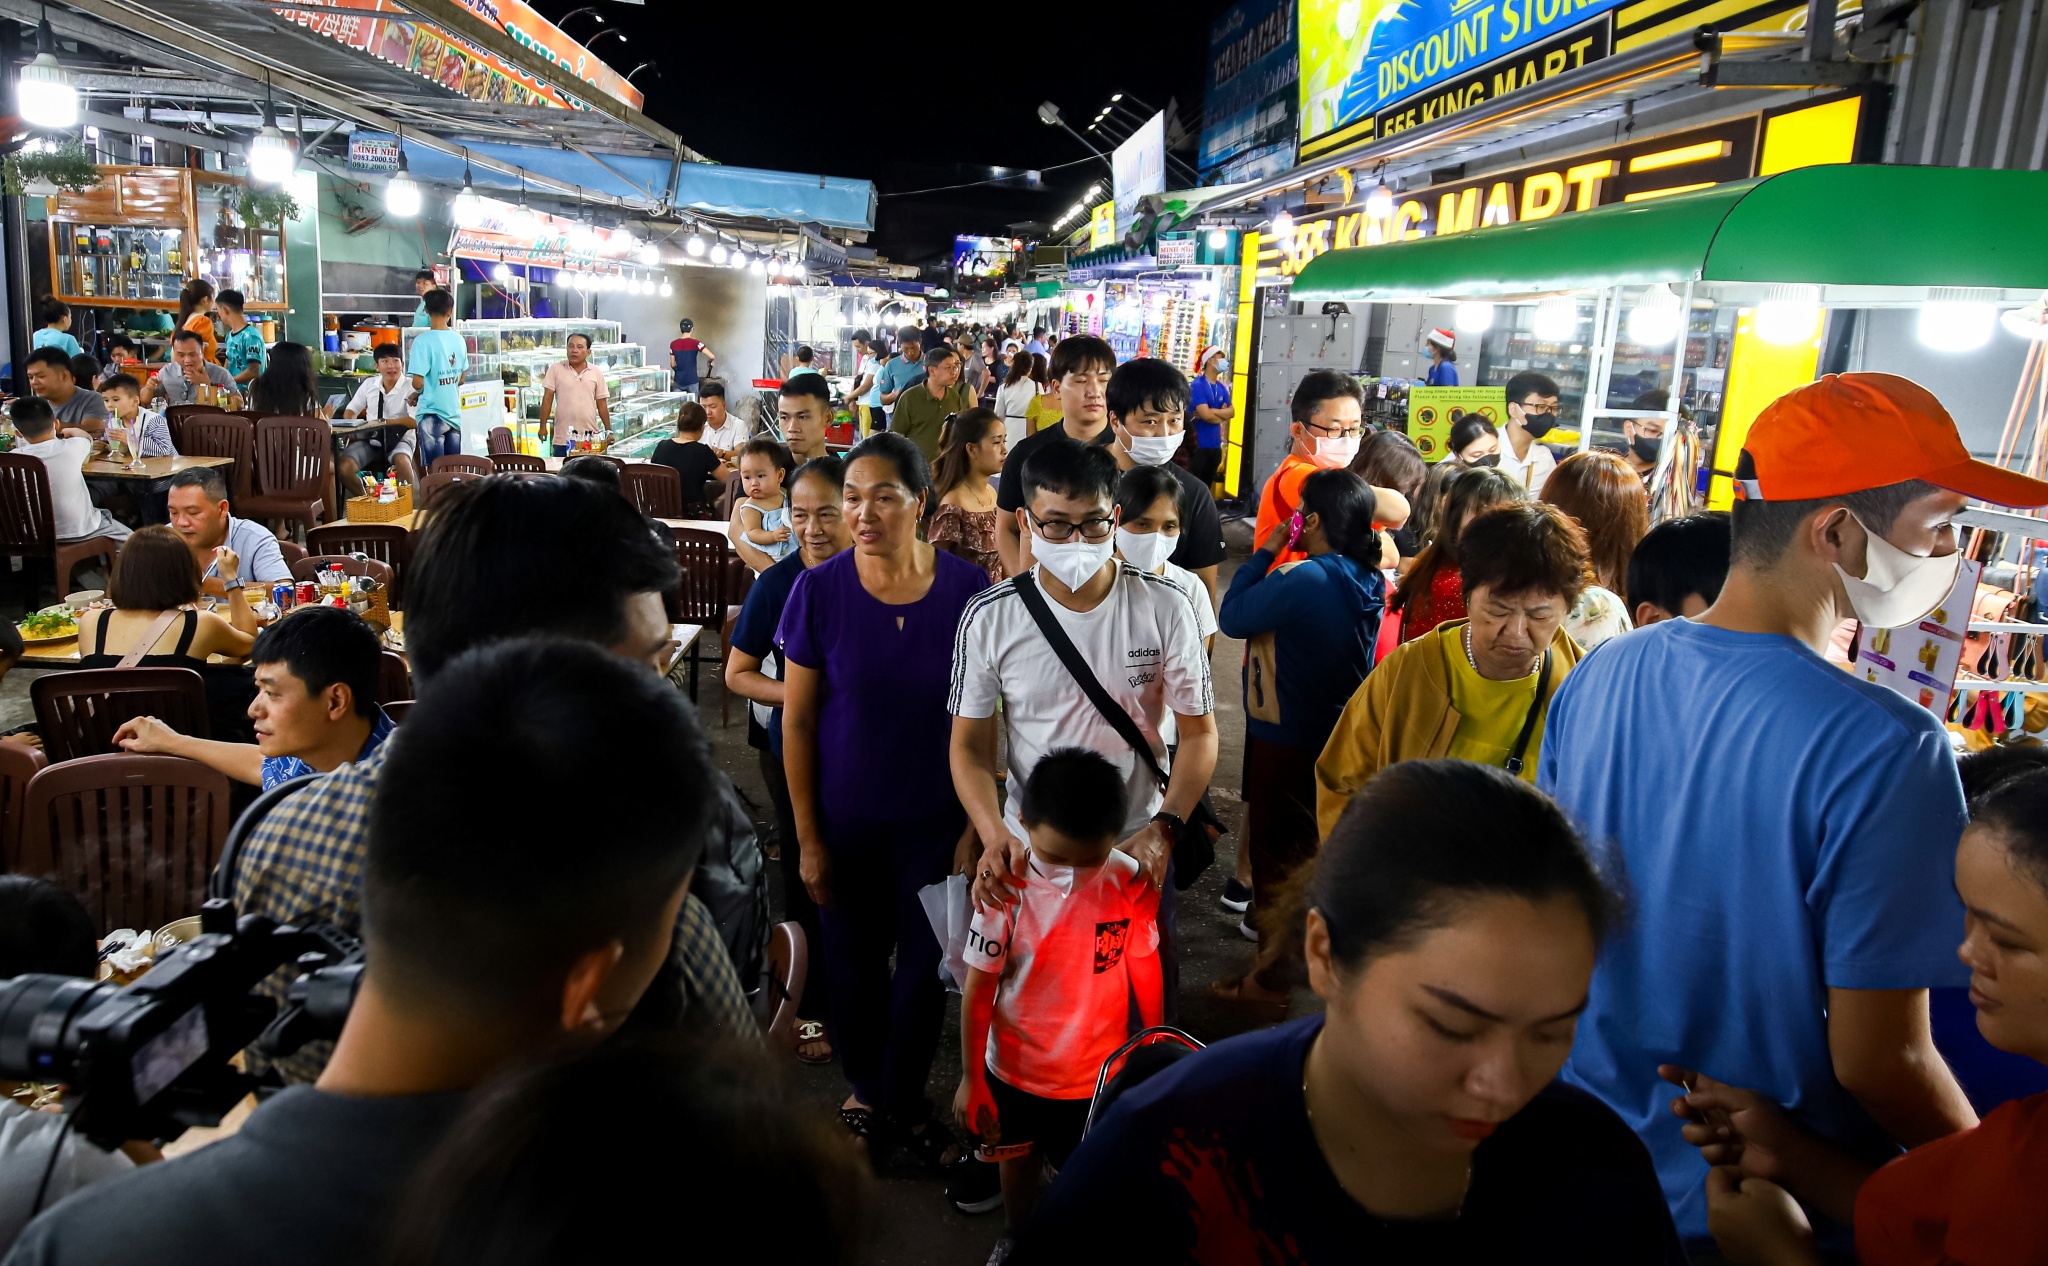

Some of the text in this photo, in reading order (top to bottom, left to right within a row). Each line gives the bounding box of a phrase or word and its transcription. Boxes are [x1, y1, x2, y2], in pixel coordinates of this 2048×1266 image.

[1378, 5, 1495, 100] DISCOUNT
[1384, 36, 1594, 136] 555 KING MART
[353, 146, 378, 155] MINH
[1282, 159, 1620, 276] 555 KING MART
[1128, 648, 1161, 658] adidas
